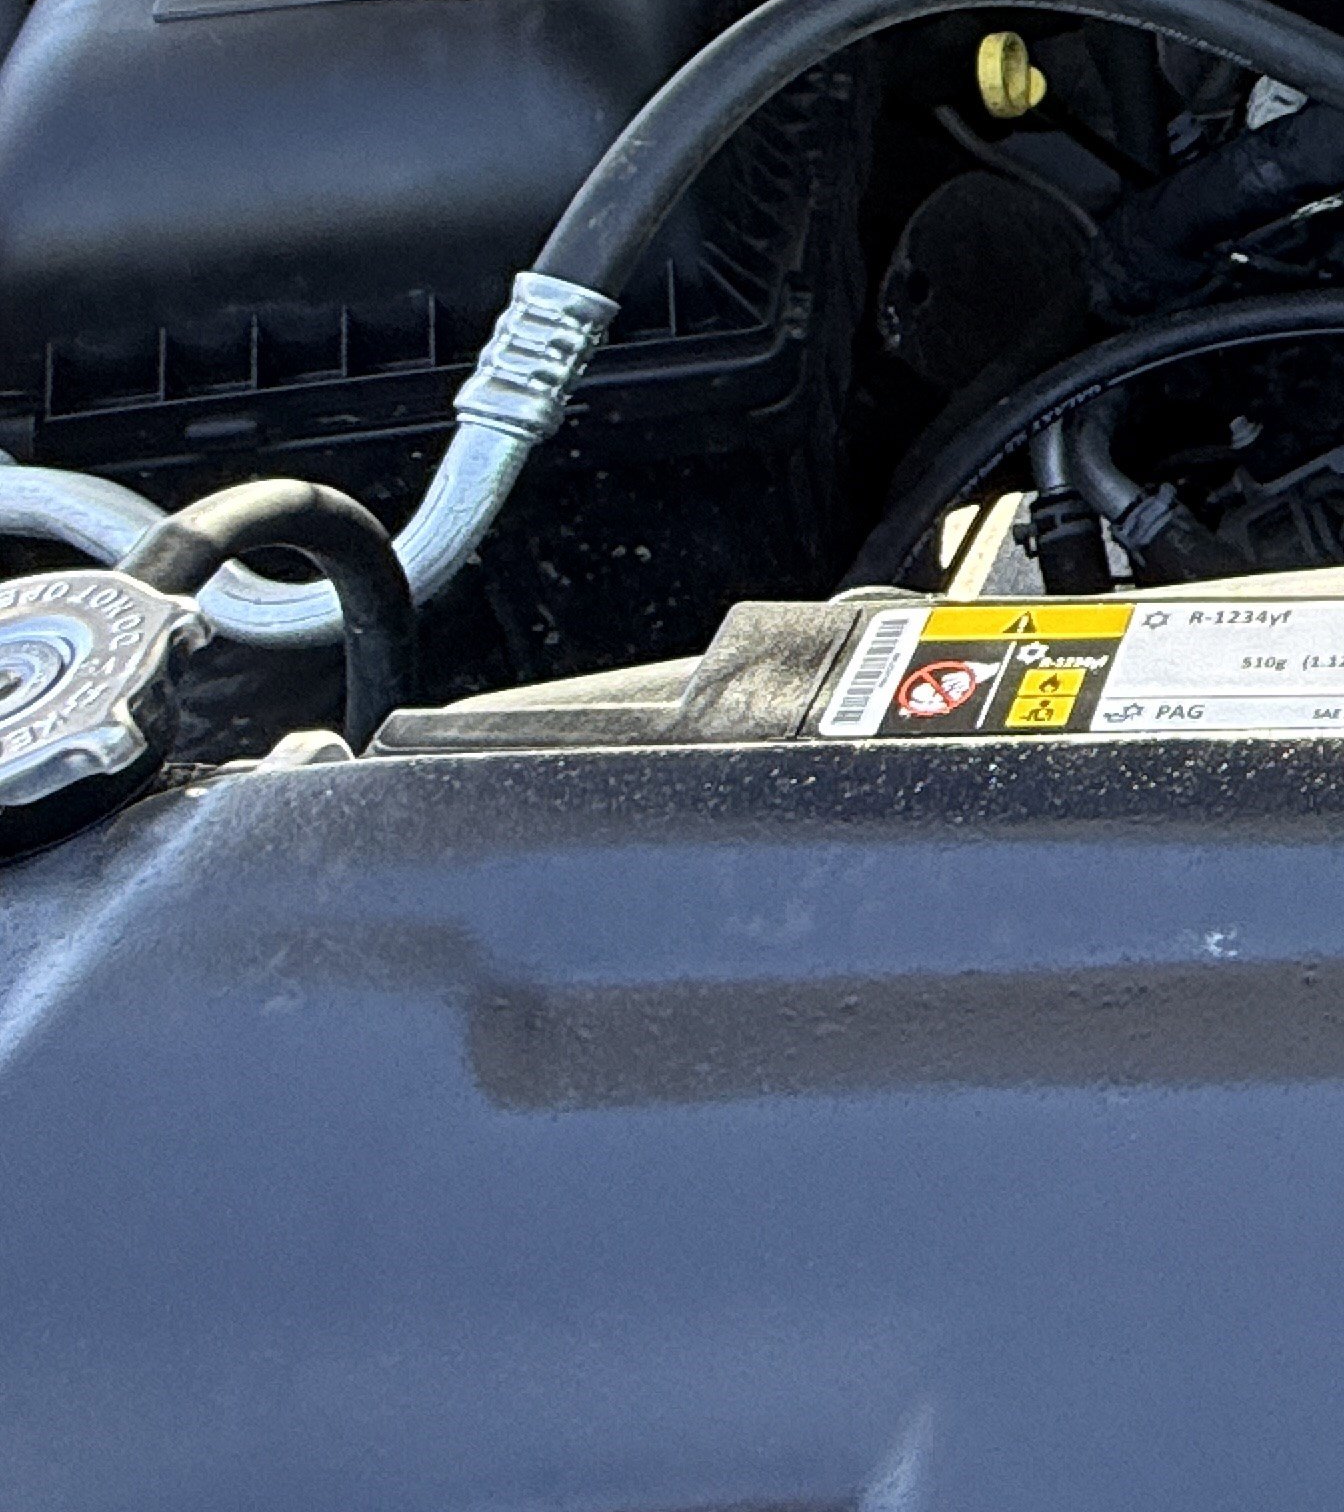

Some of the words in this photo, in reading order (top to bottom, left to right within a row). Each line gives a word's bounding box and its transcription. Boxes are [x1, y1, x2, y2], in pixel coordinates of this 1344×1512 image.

[1188, 609, 1293, 628] R-1234yf
[1240, 655, 1288, 671] 510g
[1155, 704, 1206, 720] PAG
[1312, 708, 1342, 720] SAE
